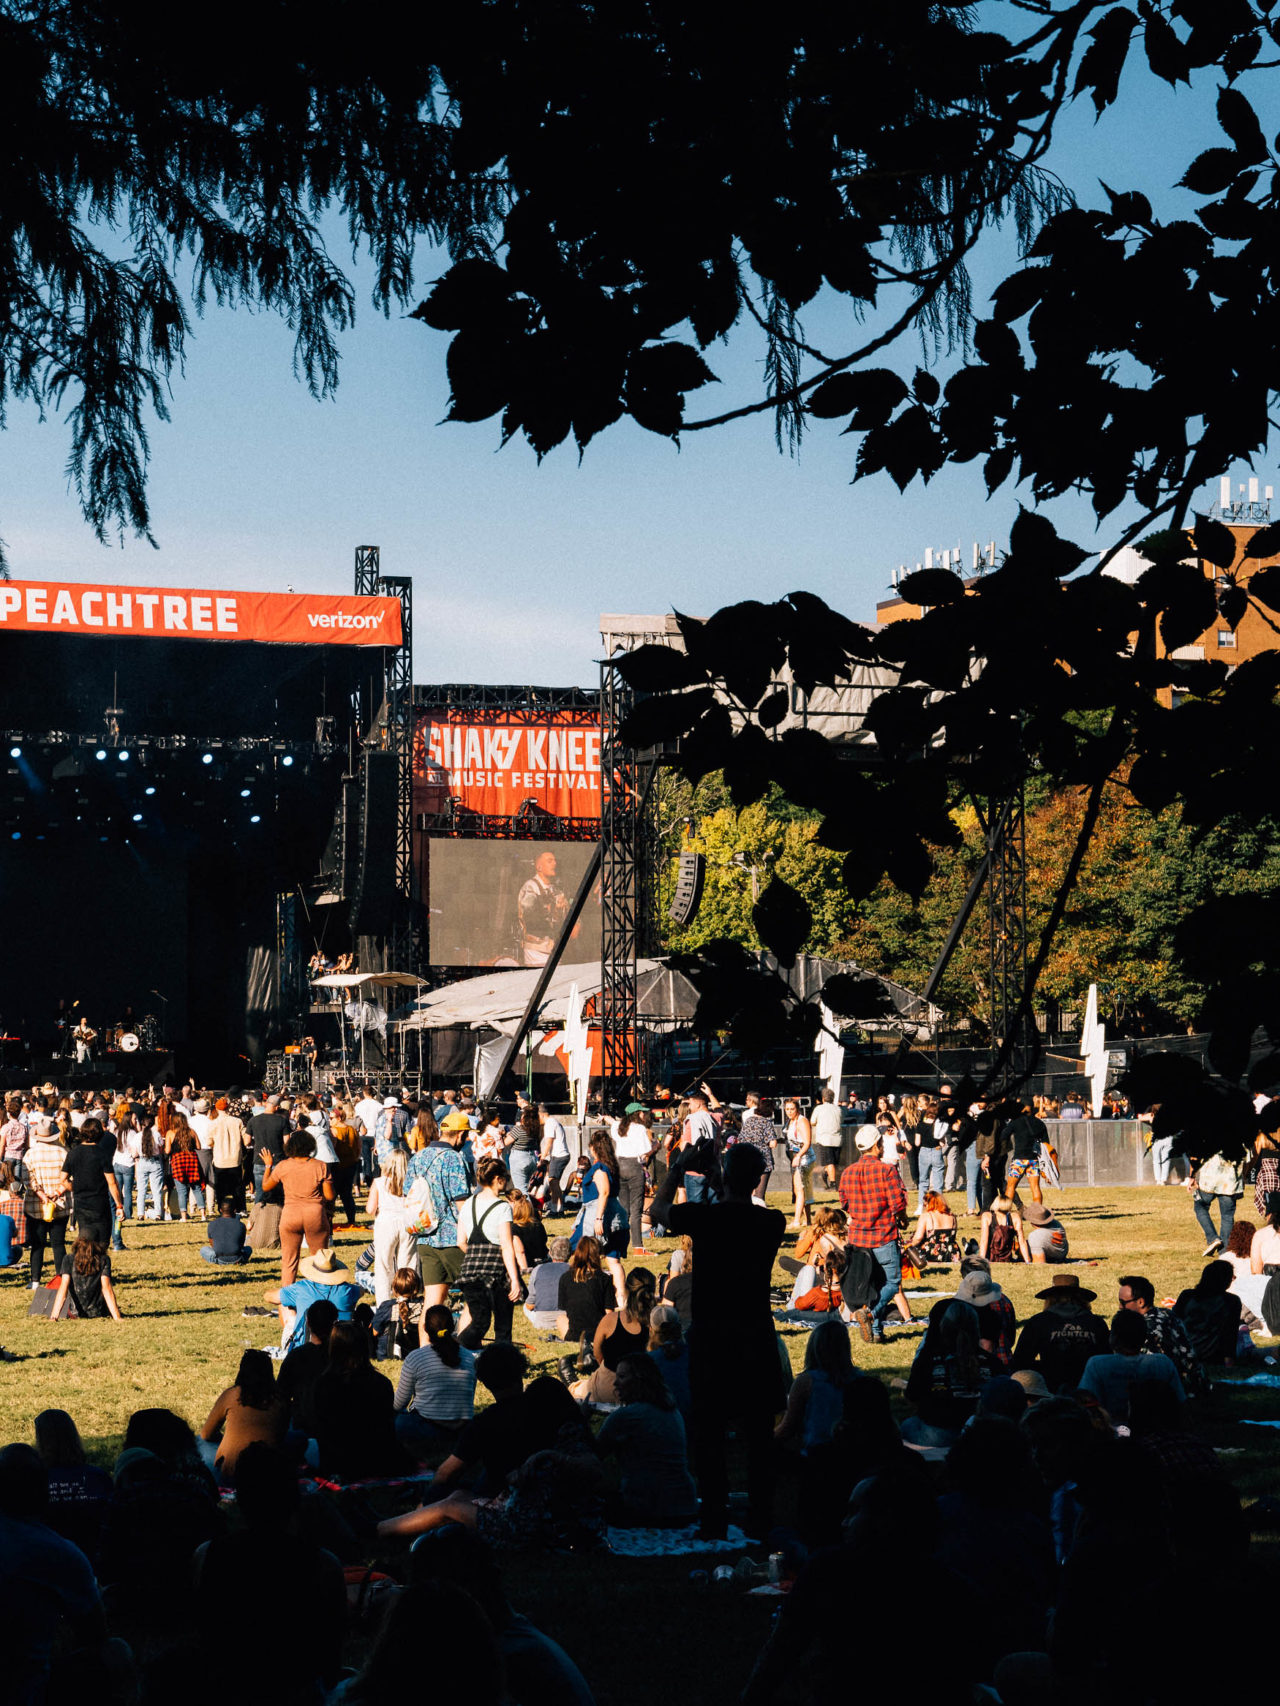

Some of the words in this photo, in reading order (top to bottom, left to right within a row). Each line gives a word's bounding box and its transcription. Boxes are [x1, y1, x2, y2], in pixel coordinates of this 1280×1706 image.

[307, 611, 378, 629] verizon
[424, 727, 522, 770] SHAKY
[448, 771, 503, 788] MUSIC
[512, 772, 599, 789] FESTIVAL
